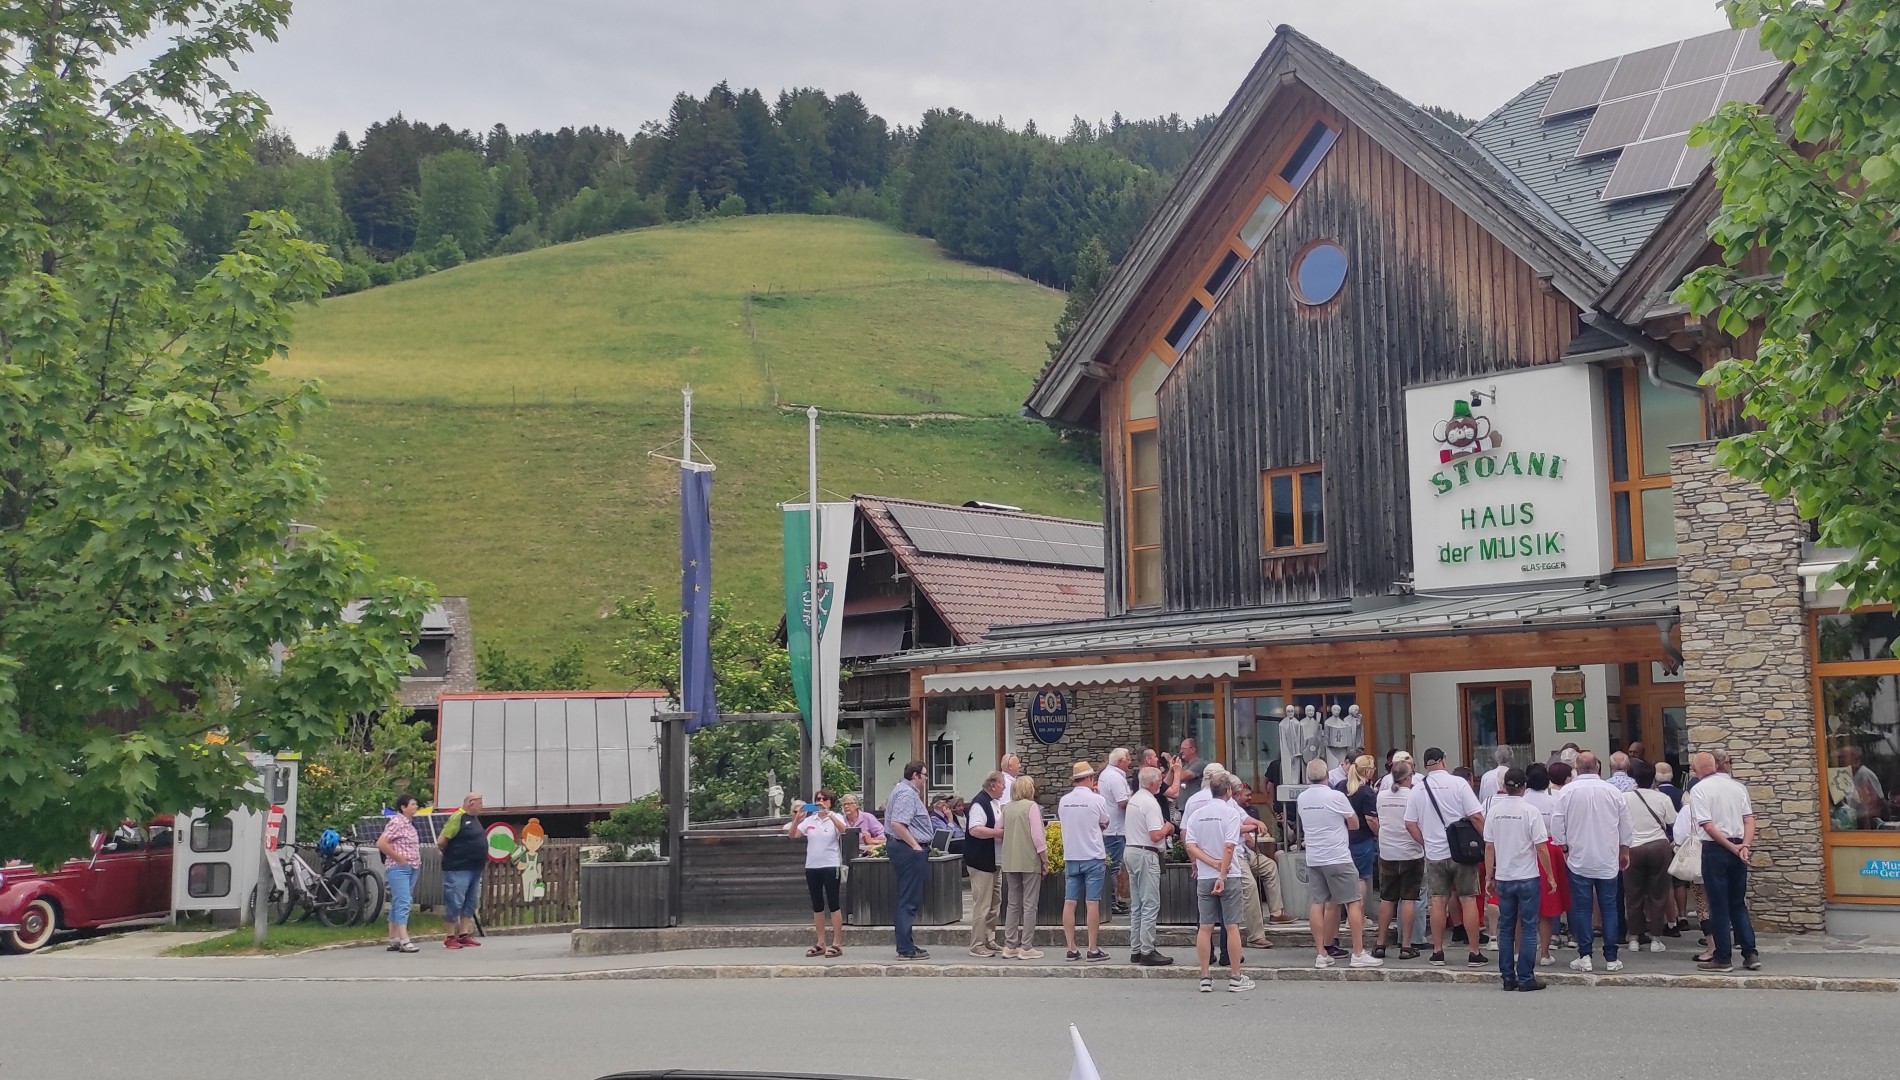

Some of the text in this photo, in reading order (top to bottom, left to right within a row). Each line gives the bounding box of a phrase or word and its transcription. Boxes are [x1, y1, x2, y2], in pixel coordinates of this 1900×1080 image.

[1431, 451, 1562, 494] STOANI
[1461, 502, 1534, 530] HAUS
[1440, 532, 1561, 563] der MUSIK
[1870, 861, 1878, 869] A
